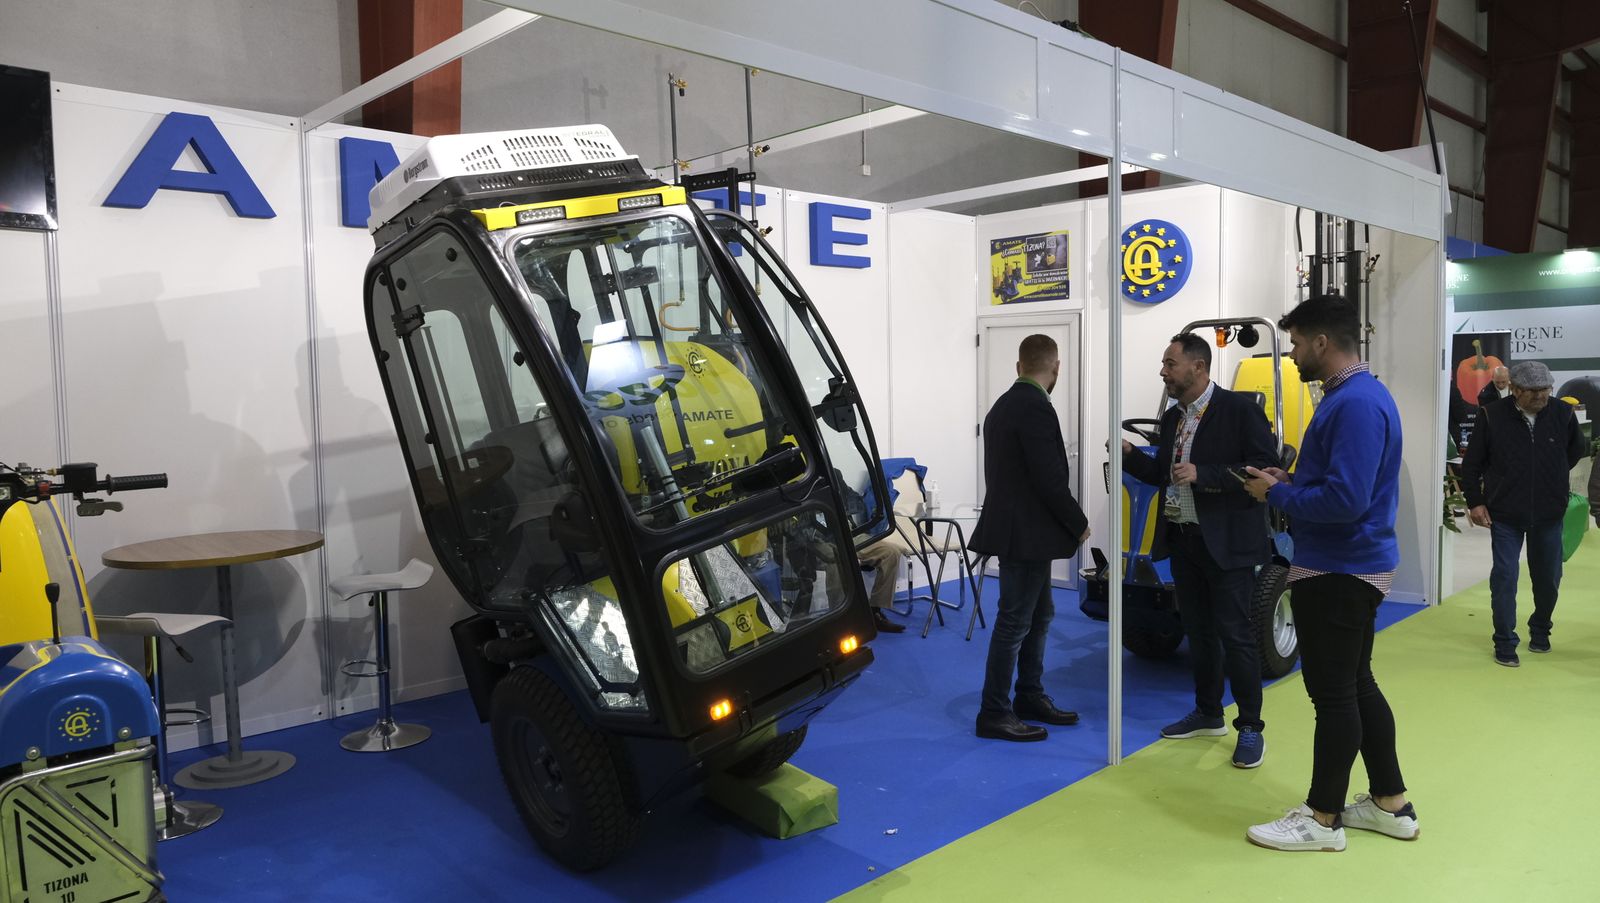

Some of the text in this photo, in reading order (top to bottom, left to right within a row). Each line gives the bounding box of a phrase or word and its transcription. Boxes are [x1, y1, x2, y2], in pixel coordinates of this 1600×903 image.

[682, 409, 734, 422] AMATE
[43, 872, 89, 894] TIZONA
[61, 891, 76, 903] 10
